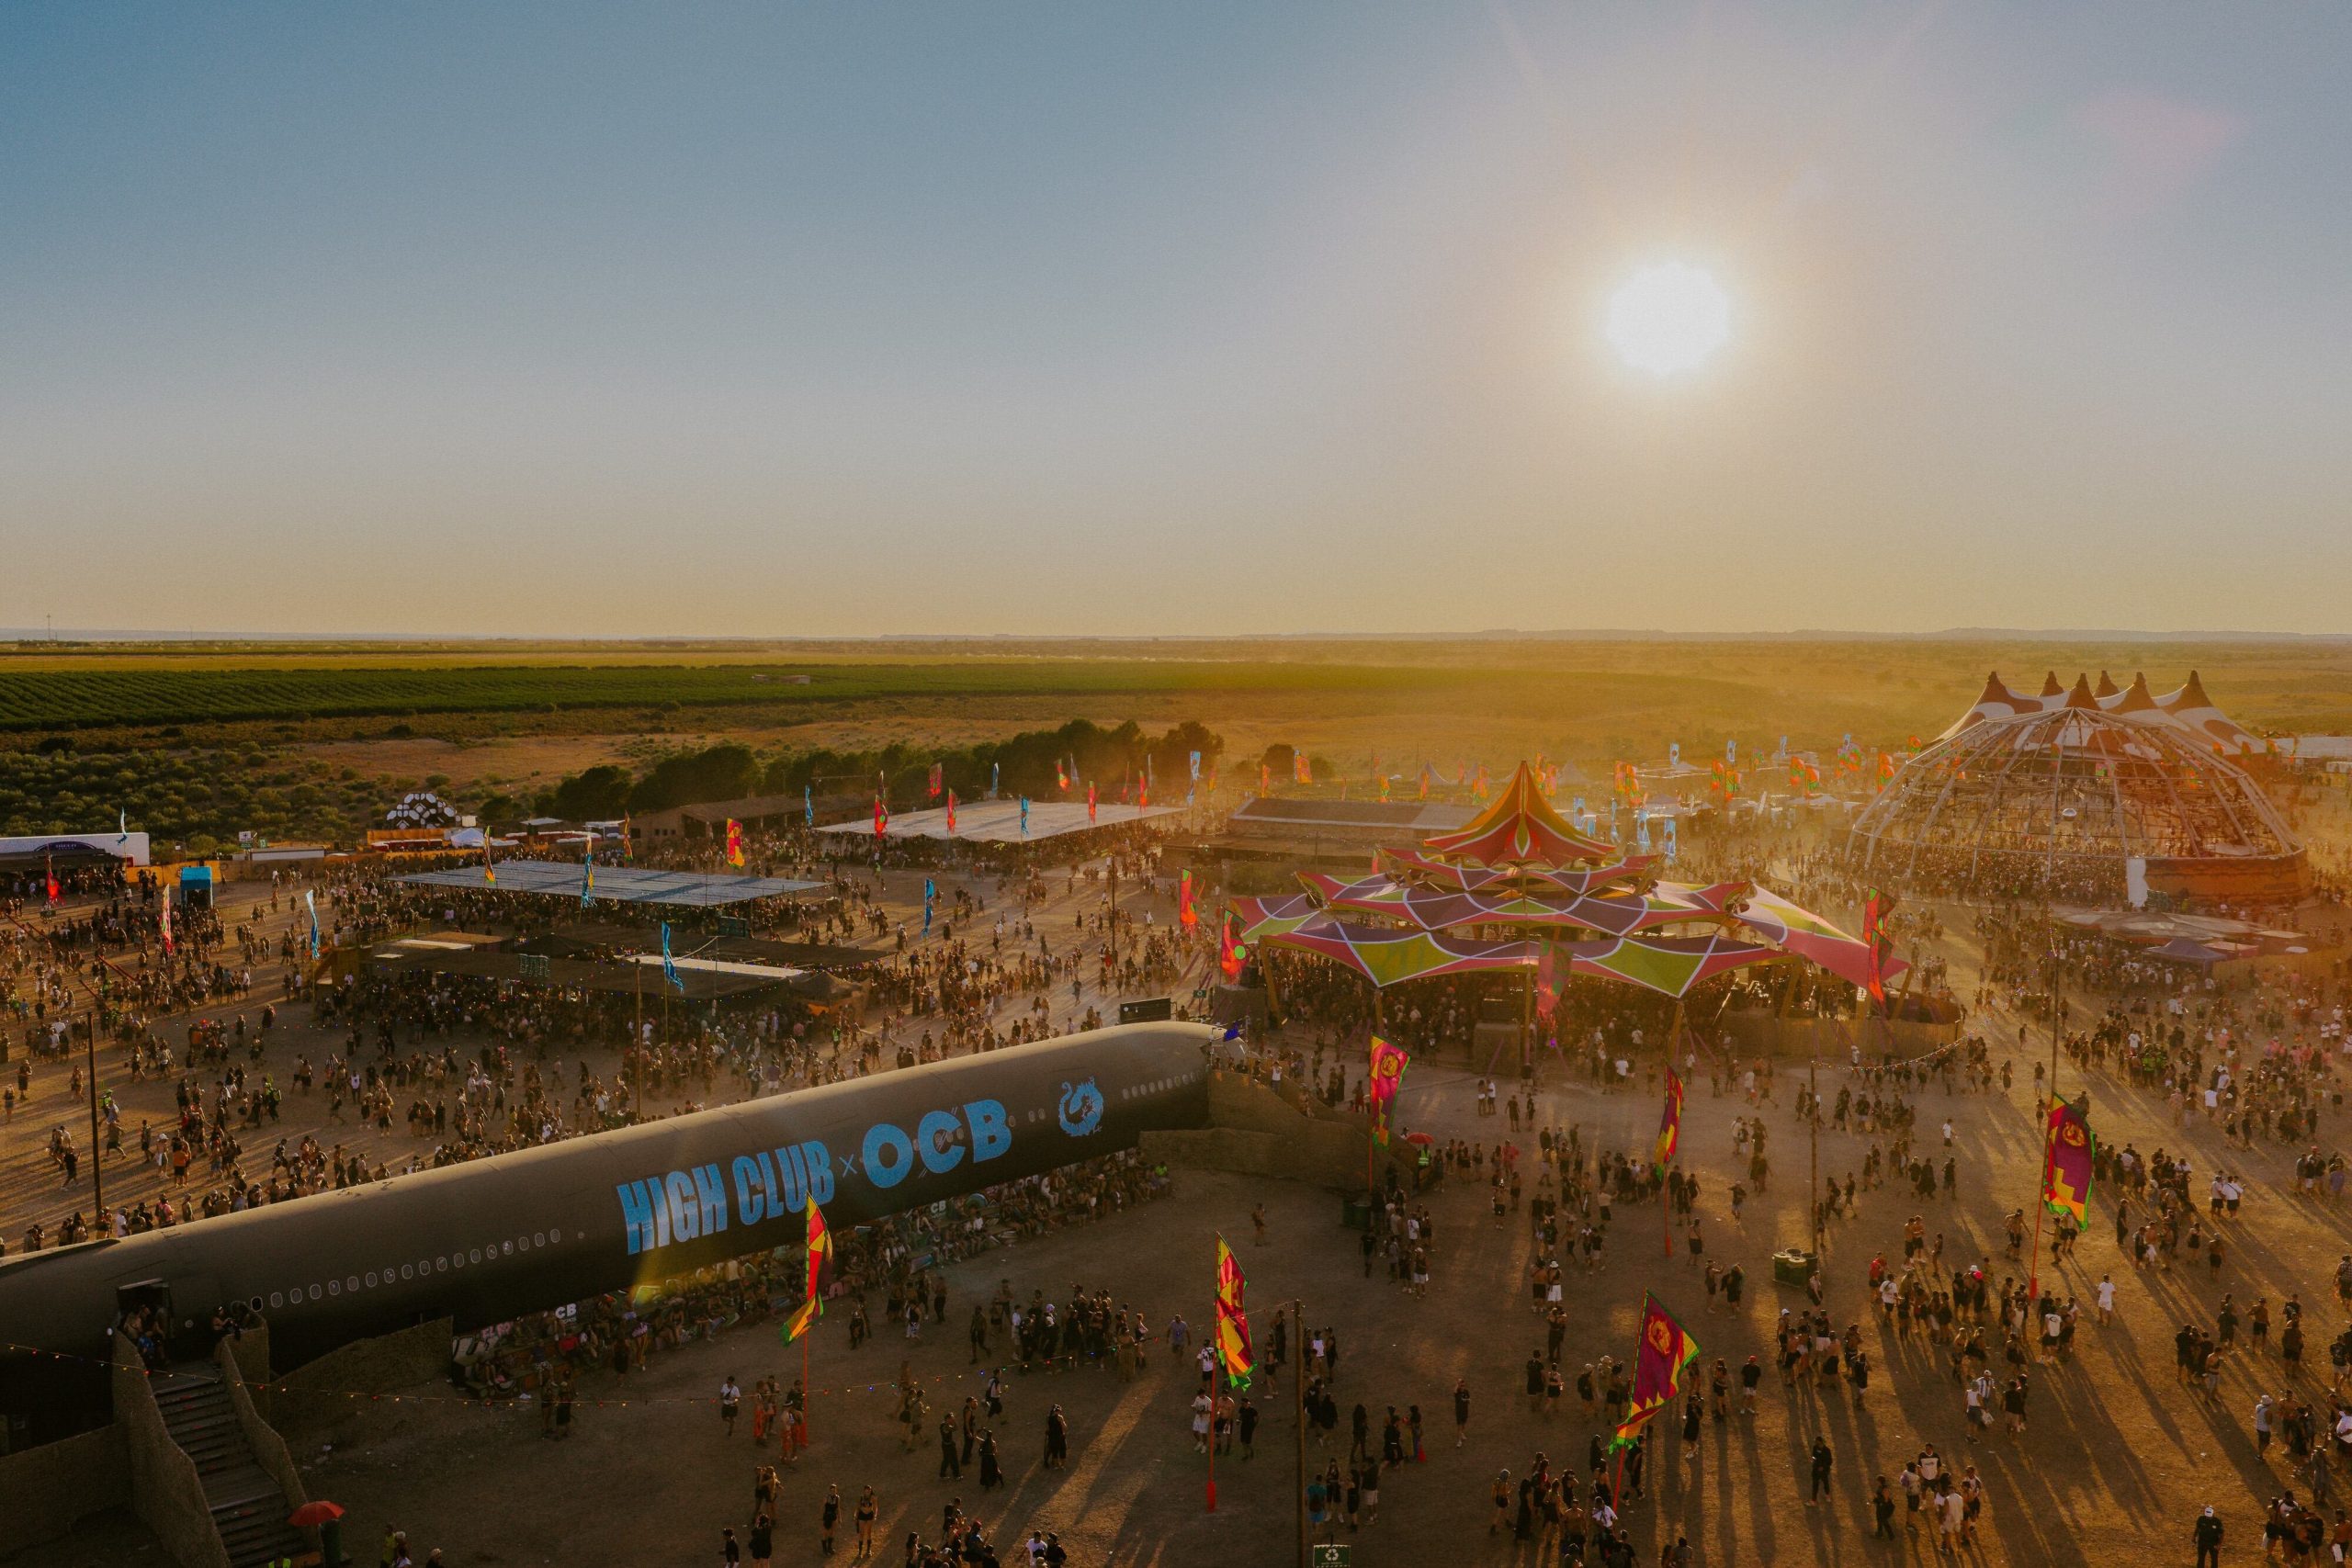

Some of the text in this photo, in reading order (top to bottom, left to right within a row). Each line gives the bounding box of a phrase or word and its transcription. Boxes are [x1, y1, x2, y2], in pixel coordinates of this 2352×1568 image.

[616, 1163, 728, 1256] HIGH
[732, 1140, 835, 1225] CLUB
[862, 1099, 1012, 1189] OCB
[930, 1200, 946, 1213] CB
[555, 1303, 577, 1319] CB
